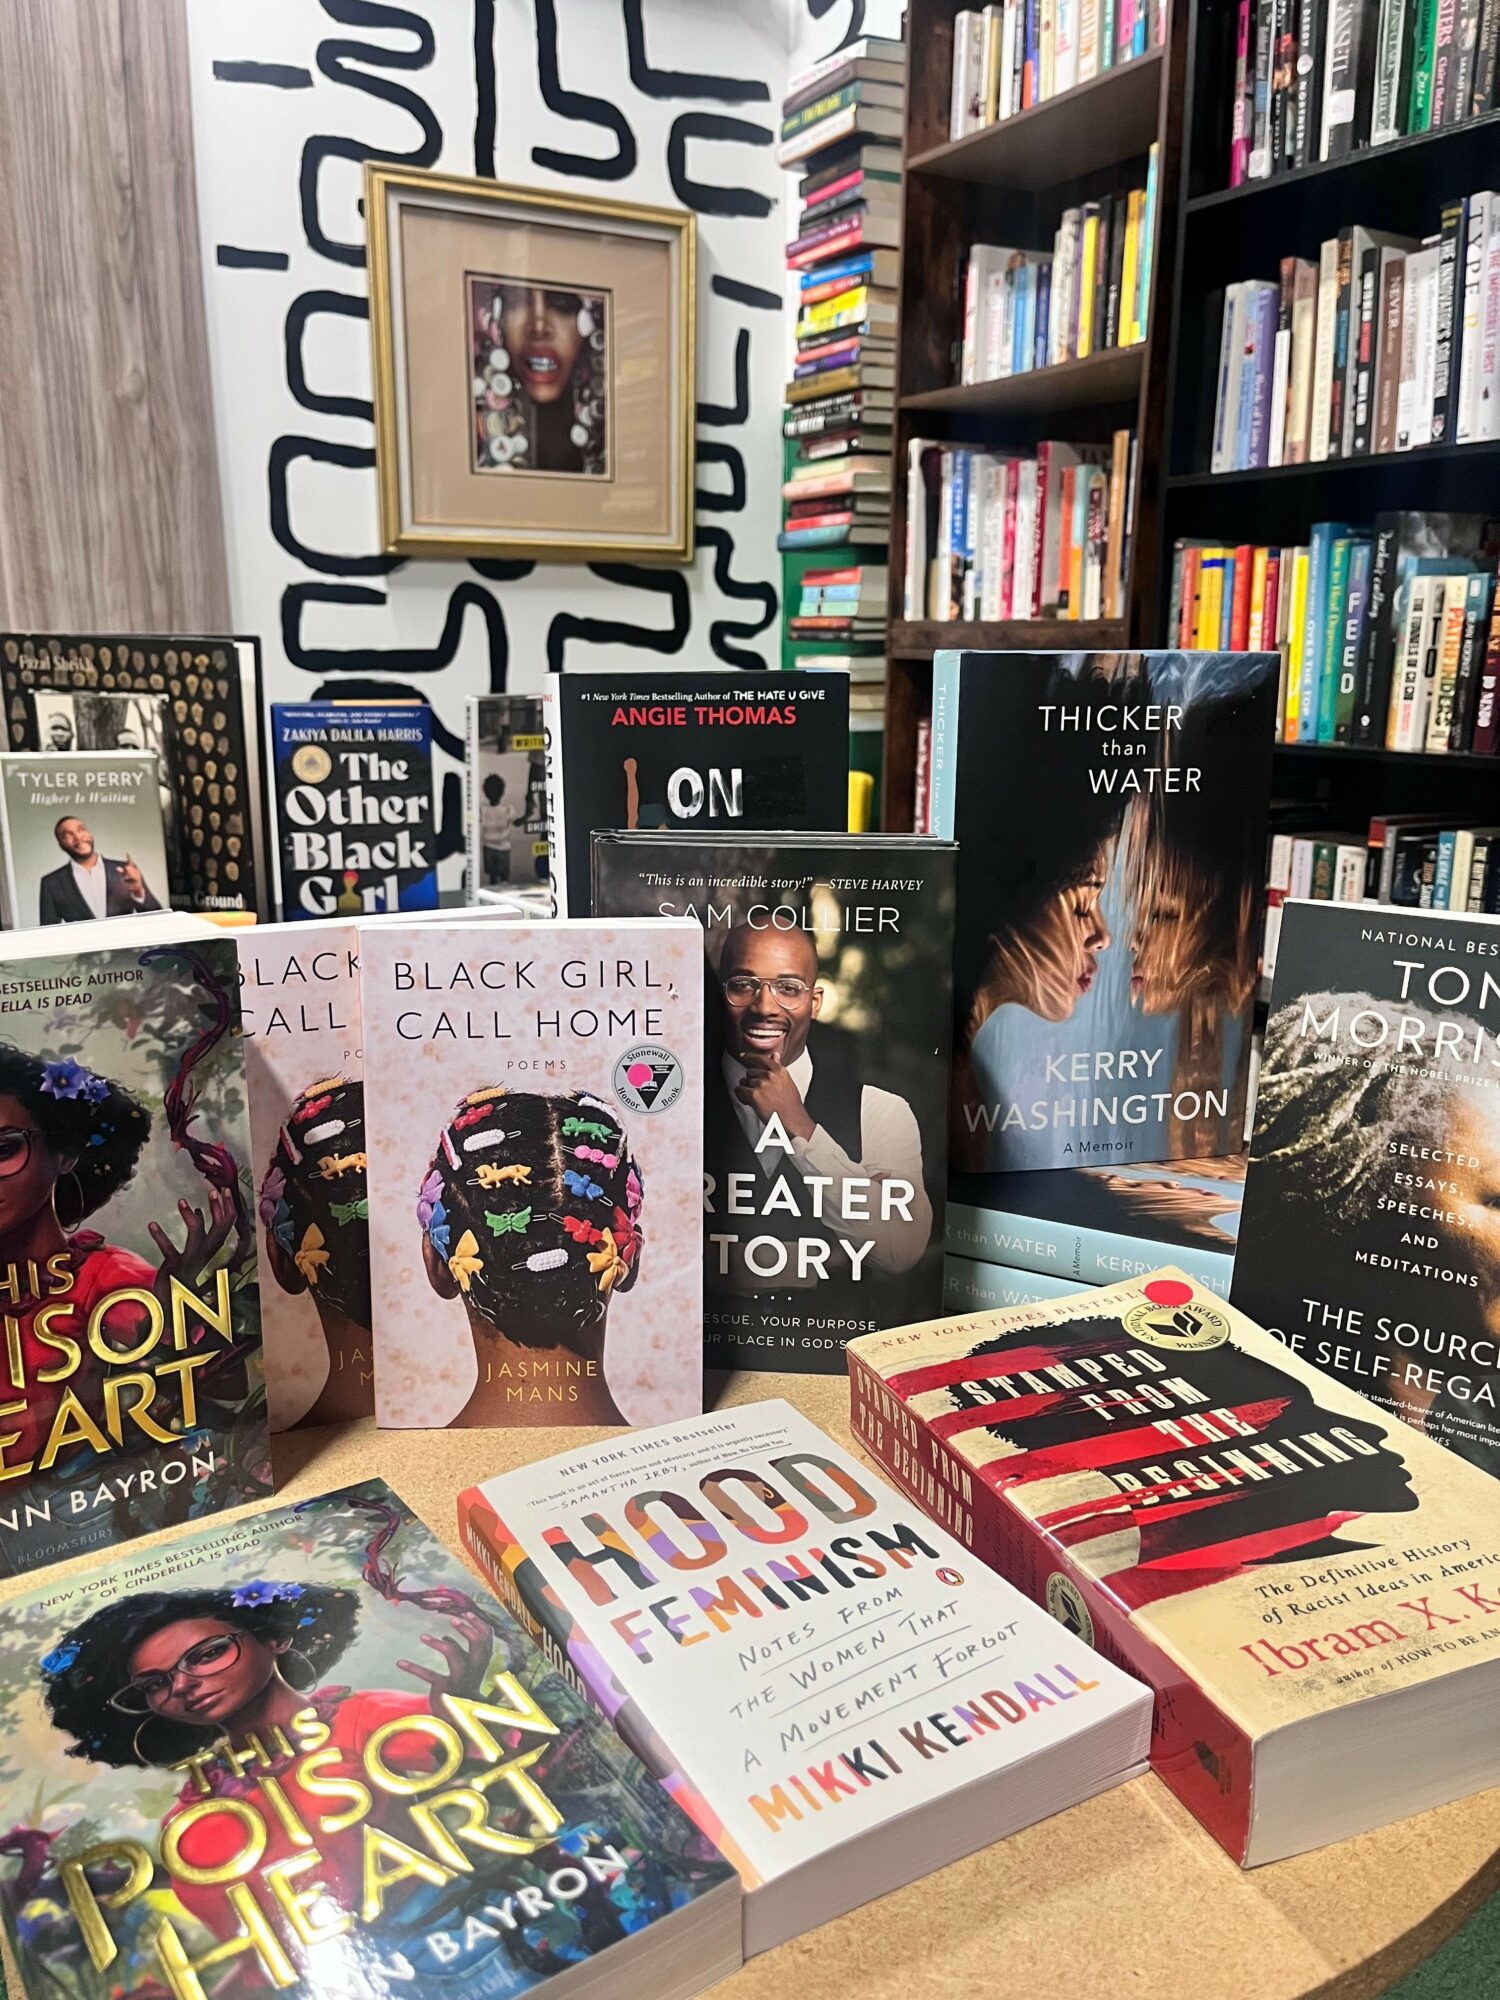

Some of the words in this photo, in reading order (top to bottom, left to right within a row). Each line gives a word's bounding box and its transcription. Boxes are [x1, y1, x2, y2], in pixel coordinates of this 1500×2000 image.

[1465, 206, 1484, 295] TYPE
[1435, 607, 1464, 727] PATHFINDERS
[581, 691, 591, 701] #1
[593, 691, 611, 701] New
[612, 691, 628, 701] York
[629, 691, 650, 702] Times
[652, 691, 693, 703] Bestselling
[694, 691, 721, 702] Author
[722, 691, 731, 701] of
[733, 690, 755, 701] THE
[757, 690, 787, 701] HATE
[788, 691, 797, 701] U
[799, 690, 826, 701] GIVE
[611, 706, 688, 726] ANGIE
[694, 705, 797, 726] THOMAS
[936, 683, 947, 770] THICKER
[1038, 705, 1183, 732] THICKER
[282, 727, 328, 742] ZAKIYA
[330, 728, 375, 743] DALILA
[377, 728, 424, 743] HARRIS
[1102, 739, 1147, 756] than
[16, 771, 79, 788] TYLER
[86, 771, 145, 788] PERRY
[338, 752, 410, 781] The
[1088, 767, 1202, 795] WATER
[30, 792, 71, 806] Higher
[89, 792, 137, 804] Waiting
[285, 784, 429, 826] Other
[667, 766, 744, 819] ON
[289, 830, 430, 871] Black
[671, 874, 686, 887] is
[688, 876, 704, 887] an
[708, 874, 768, 889] incredible
[872, 879, 925, 892] HARVEY
[747, 904, 900, 934] COLLIER
[1361, 928, 1457, 952] NATIONAL
[87, 969, 144, 986] AUTHOR
[394, 961, 536, 990] BLACK
[561, 960, 675, 992] GIRL,
[38, 995, 50, 1009] IS
[55, 992, 93, 1007] DEAD
[396, 1011, 512, 1040] CALL
[537, 1008, 664, 1038] HOME
[507, 1059, 567, 1070] POEMS
[627, 1050, 670, 1062] Stonewall
[1045, 1048, 1163, 1084] KERRY
[1313, 1051, 1359, 1068] WINNER
[1383, 1063, 1406, 1074] THE
[1410, 1066, 1450, 1081] NOBEL
[1455, 1074, 1492, 1087] PRIZE
[617, 1086, 640, 1109] Honor
[661, 1086, 680, 1106] Book
[963, 1088, 1229, 1133] WASHINGTON
[754, 1111, 796, 1156] A
[1063, 1143, 1073, 1154] A
[1079, 1140, 1134, 1153] Memoir
[1389, 1142, 1480, 1169] SELECTED
[1394, 1172, 1464, 1197] ESSAYS,
[1376, 1198, 1473, 1229] SPEECHES,
[957, 1230, 988, 1245] than
[994, 1233, 1057, 1258] WATER
[1400, 1232, 1439, 1249] AND
[1355, 1250, 1479, 1288] MEDITATIONS
[965, 1284, 996, 1300] than
[760, 1316, 801, 1328] YOUR
[807, 1318, 881, 1332] PURPOSE,
[881, 1333, 922, 1348] NEW
[932, 1321, 984, 1337] YORK
[988, 1311, 1048, 1328] TIMES
[1183, 1304, 1223, 1327] AWARD
[1302, 1298, 1365, 1335] THE
[728, 1334, 775, 1347] PLACE
[780, 1337, 796, 1347] IN
[1176, 1335, 1223, 1349] WINNER
[485, 1360, 597, 1382] JASMINE
[961, 1348, 1168, 1407] STAMPED
[506, 1385, 578, 1402] MANS
[1079, 1376, 1211, 1421] FROM
[1150, 1407, 1260, 1449] THE
[1370, 1394, 1434, 1417] standard-bearer
[1435, 1410, 1445, 1418] of
[1446, 1412, 1487, 1431] American
[1407, 1415, 1440, 1431] perhaps
[1441, 1423, 1456, 1435] her
[1457, 1429, 1478, 1440] most
[559, 1462, 589, 1478] NEW
[592, 1449, 627, 1466] YORK
[630, 1437, 671, 1456] TIMES
[673, 1421, 737, 1444] Bestseller
[855, 1365, 919, 1449] STAMPED
[931, 1440, 973, 1507] FROM
[70, 1451, 216, 1515] BAYRON
[859, 1405, 884, 1450] THE
[893, 1437, 974, 1548] BEGINNING
[1110, 1426, 1381, 1507] BEGINNING
[17, 1528, 113, 1566] BLOOMSBURY
[541, 1453, 878, 1606] HOOD
[40, 1591, 75, 1610] NEW
[80, 1575, 119, 1595] YORK
[123, 1559, 163, 1579] TIMES
[165, 1533, 249, 1564] BESTSELLING
[251, 1514, 304, 1536] AUTHOR
[100, 1585, 121, 1599] OF
[125, 1558, 206, 1589] CINDERELLA
[210, 1549, 222, 1560] IS
[225, 1538, 261, 1555] DEAD
[465, 1522, 492, 1575] MIKKI
[491, 1557, 535, 1637] KENDALL
[1255, 1583, 1295, 1600] The
[1300, 1557, 1398, 1590] Definitive
[1402, 1538, 1471, 1563] History
[610, 1522, 940, 1664] FEMINISM
[1262, 1606, 1284, 1625] of
[1288, 1592, 1351, 1616] Racist
[1355, 1576, 1409, 1599] Ideas
[1410, 1573, 1433, 1584] in
[738, 1622, 815, 1672] NOTES
[837, 1586, 904, 1625] FROM
[1239, 1619, 1408, 1677] Ibram
[1396, 1596, 1471, 1631] X.
[730, 1684, 776, 1721] THE
[789, 1629, 886, 1690] WOMEN
[898, 1600, 960, 1636] THAT
[1336, 1665, 1376, 1684] author
[1381, 1659, 1394, 1671] of
[1395, 1647, 1433, 1665] HOW
[1433, 1641, 1457, 1653] TO
[1457, 1635, 1480, 1647] BE
[744, 1748, 762, 1774] A
[780, 1663, 918, 1753] MOVEMENT
[932, 1620, 1020, 1678] FORGOT
[170, 1707, 332, 1794] THIS
[747, 1738, 903, 1833] MIKKI
[898, 1663, 1100, 1760] KENDALL
[59, 1670, 560, 1973] POISON
[153, 1742, 562, 2000] HEART
[425, 1844, 629, 1965] BAYRON
